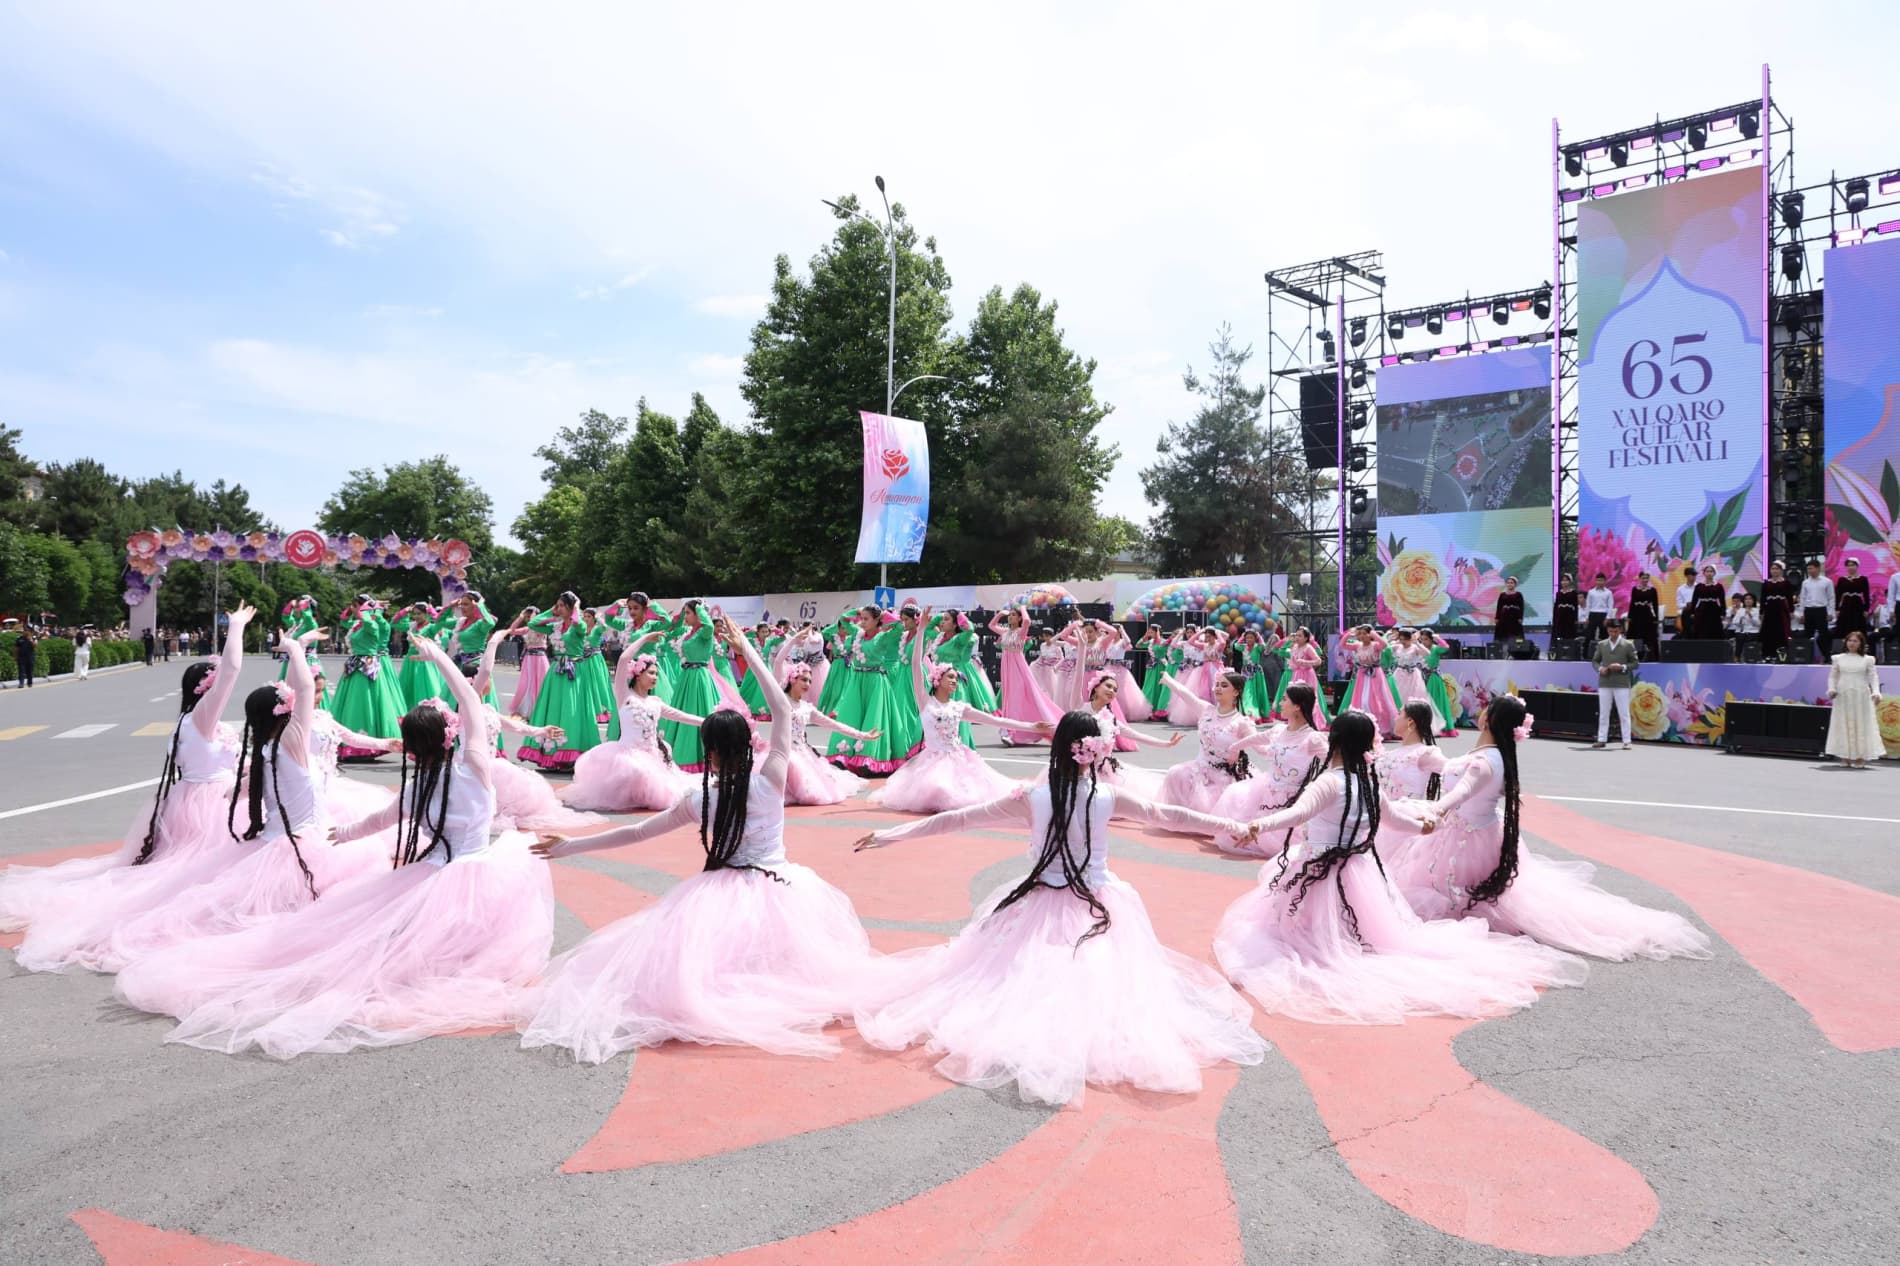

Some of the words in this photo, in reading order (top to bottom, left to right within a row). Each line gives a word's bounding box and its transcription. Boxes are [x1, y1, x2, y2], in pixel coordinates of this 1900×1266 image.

[1621, 330, 1713, 400] 65
[1612, 399, 1725, 429] XALQARO
[1622, 421, 1712, 447] GULLAR
[1608, 440, 1728, 469] FESTIVALI
[799, 600, 817, 619] 65
